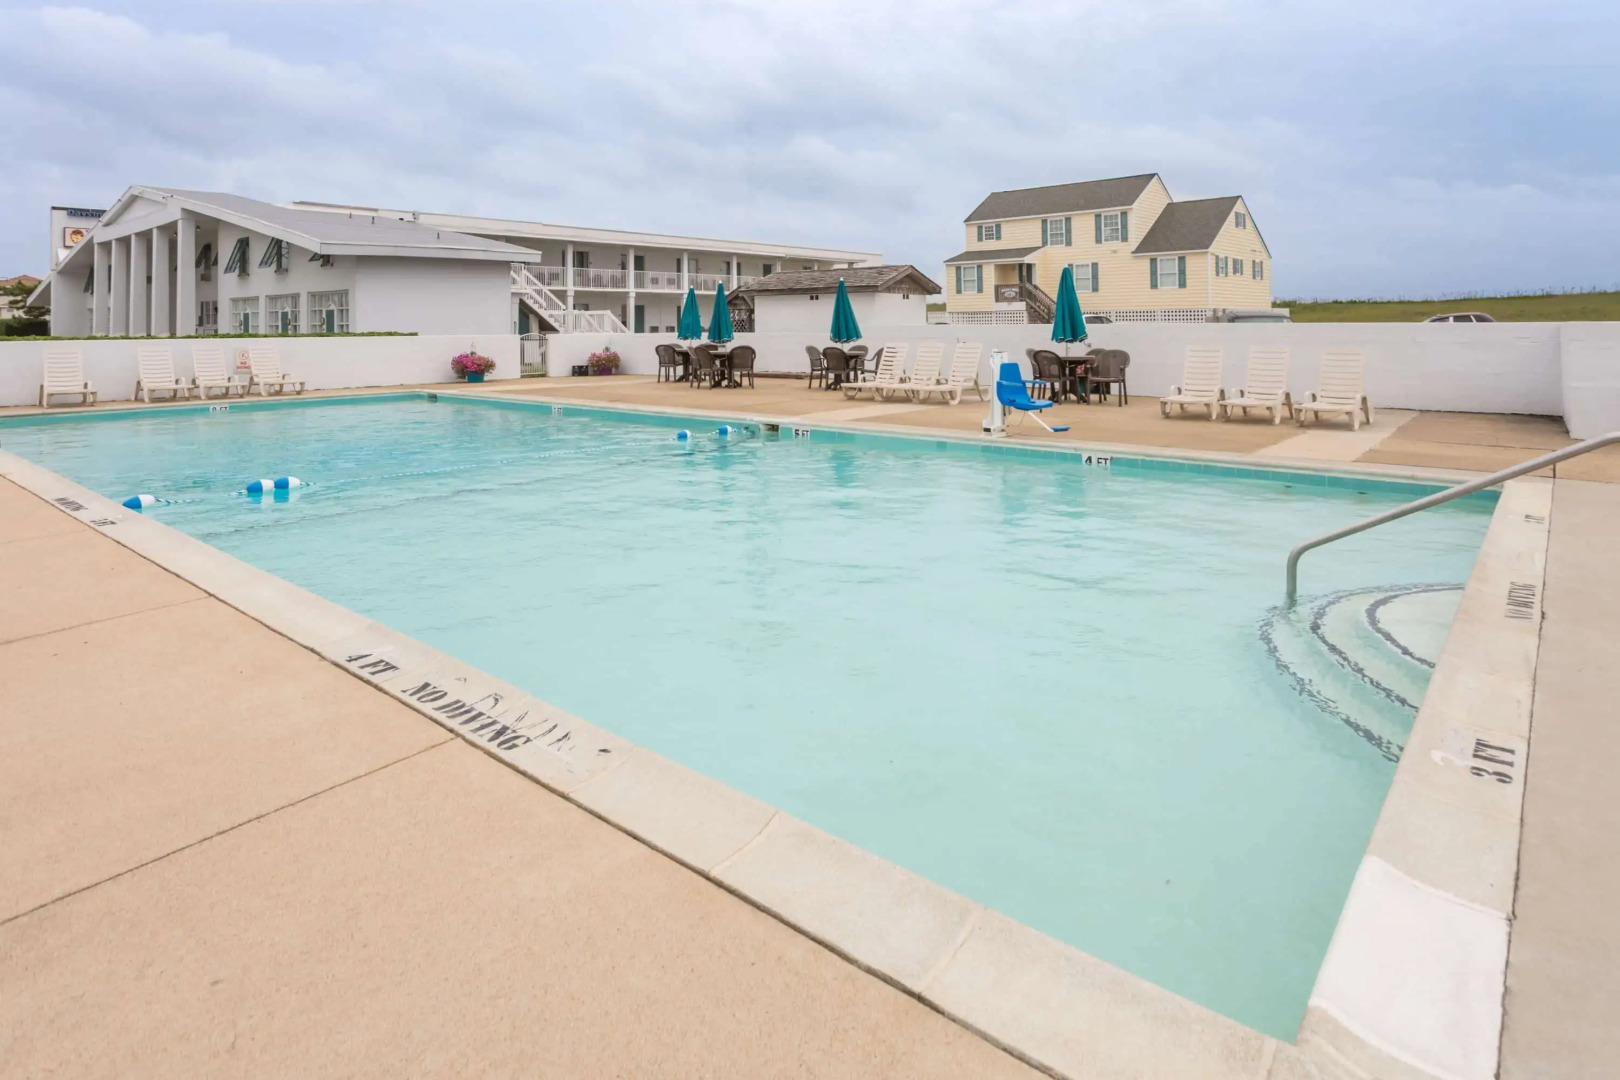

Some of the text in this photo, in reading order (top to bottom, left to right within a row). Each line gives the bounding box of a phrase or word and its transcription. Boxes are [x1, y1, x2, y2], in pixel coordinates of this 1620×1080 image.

[344, 653, 400, 676] 4 FT
[400, 681, 448, 703] NO
[432, 699, 534, 751] DIVING
[1469, 738, 1516, 784] 3 FT
